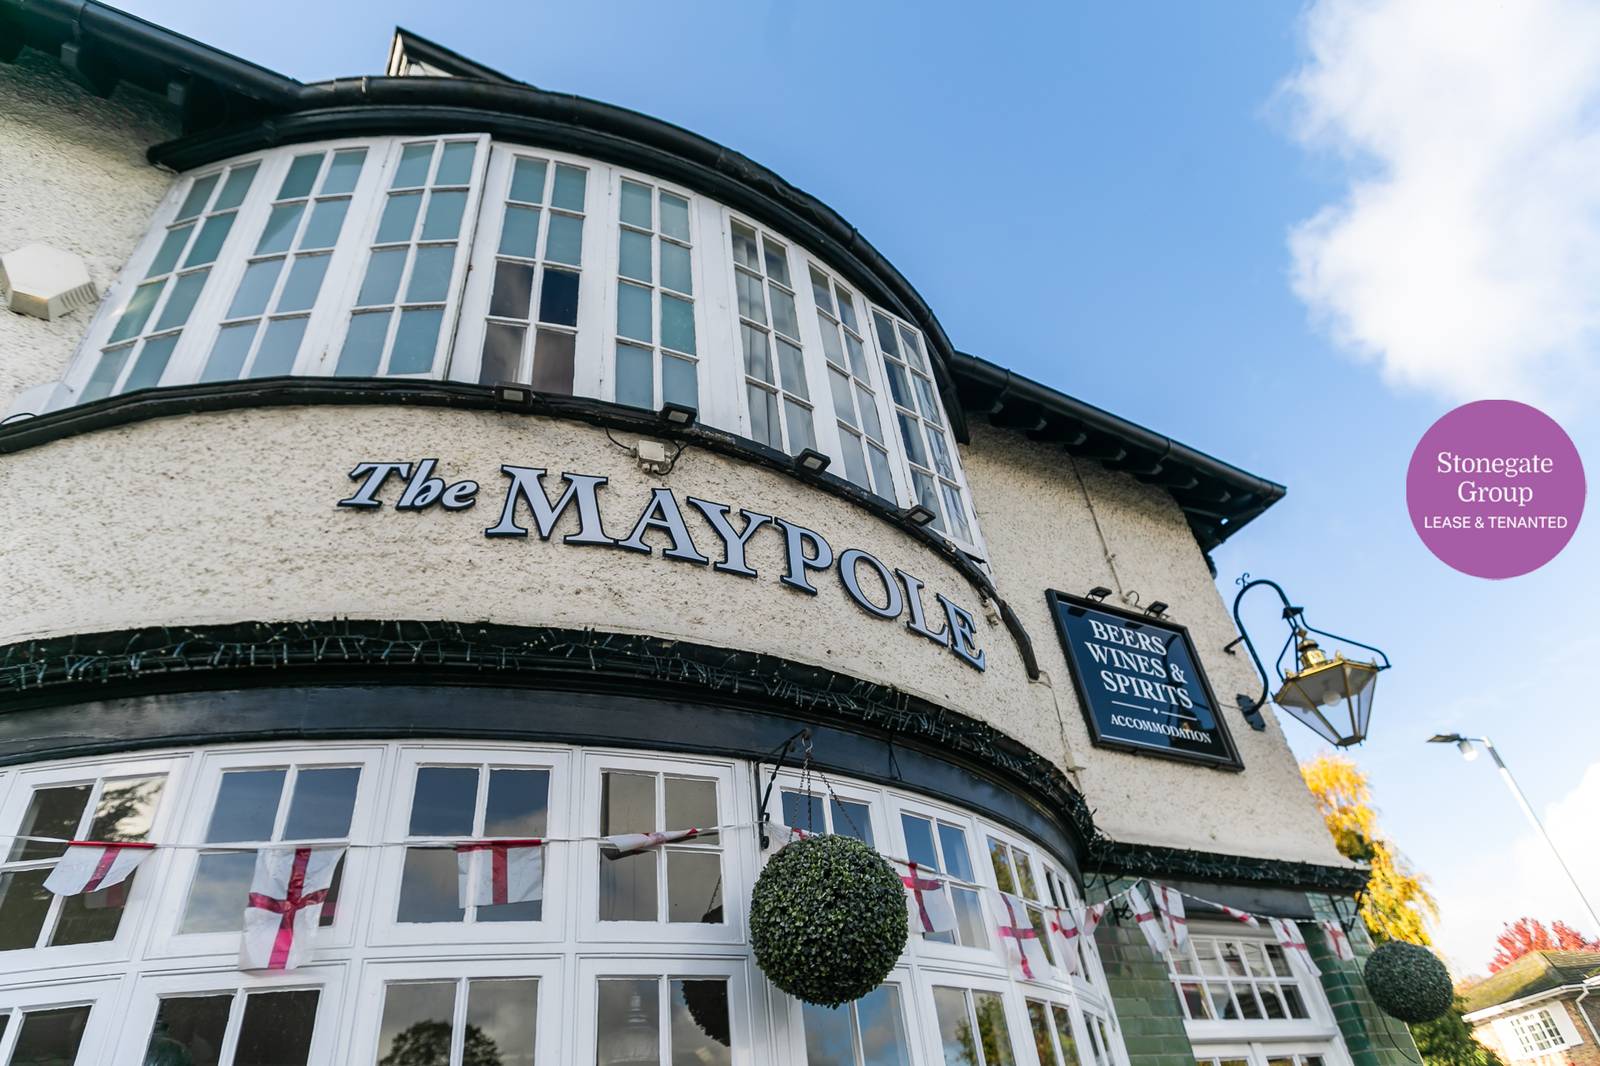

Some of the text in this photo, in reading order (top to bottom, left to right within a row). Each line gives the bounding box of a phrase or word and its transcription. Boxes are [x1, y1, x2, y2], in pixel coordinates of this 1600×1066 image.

[338, 458, 986, 672] The MAYPOLE
[1088, 619, 1167, 656] BEERS
[1084, 641, 1188, 685] WINES &
[1100, 670, 1194, 709] SPIRITS
[1111, 714, 1213, 744] ACCOMMODATION
